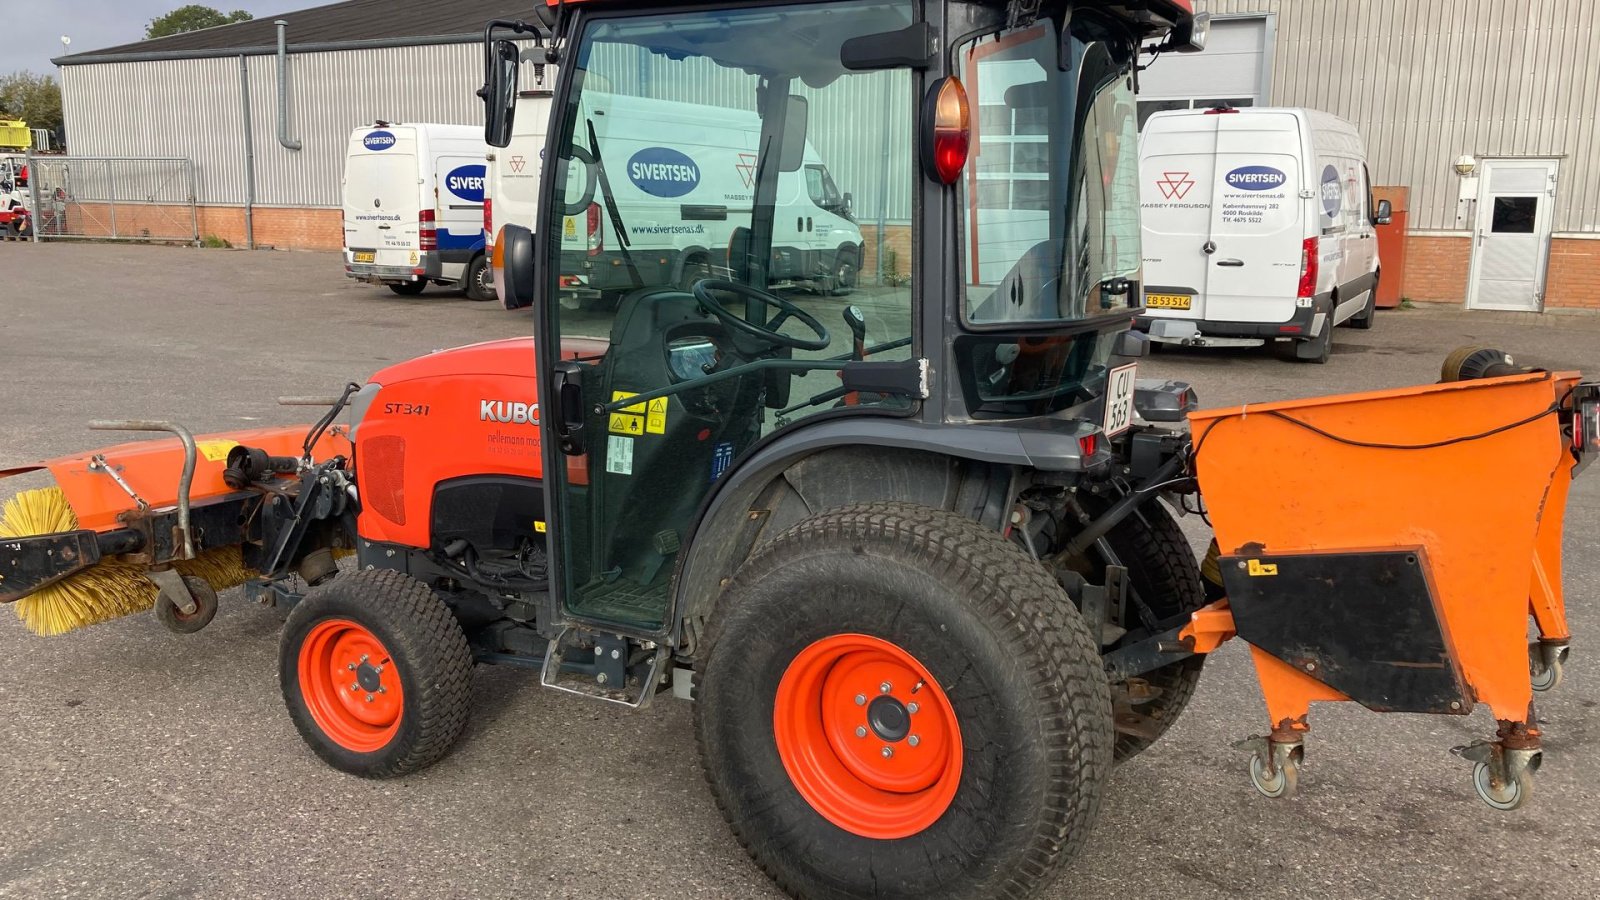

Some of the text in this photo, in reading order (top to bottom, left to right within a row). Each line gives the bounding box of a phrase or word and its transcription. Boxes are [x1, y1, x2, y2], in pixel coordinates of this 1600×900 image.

[364, 136, 394, 145] SIVERTSEN
[631, 161, 697, 182] SIVERTSEN
[1229, 173, 1283, 183] SIVERTSEN
[631, 223, 705, 235] www.sivertsenas.dk
[1146, 296, 1189, 306] EB 53 514
[1117, 371, 1130, 399] CU
[1110, 400, 1128, 430] 563
[487, 429, 525, 446] nellemann
